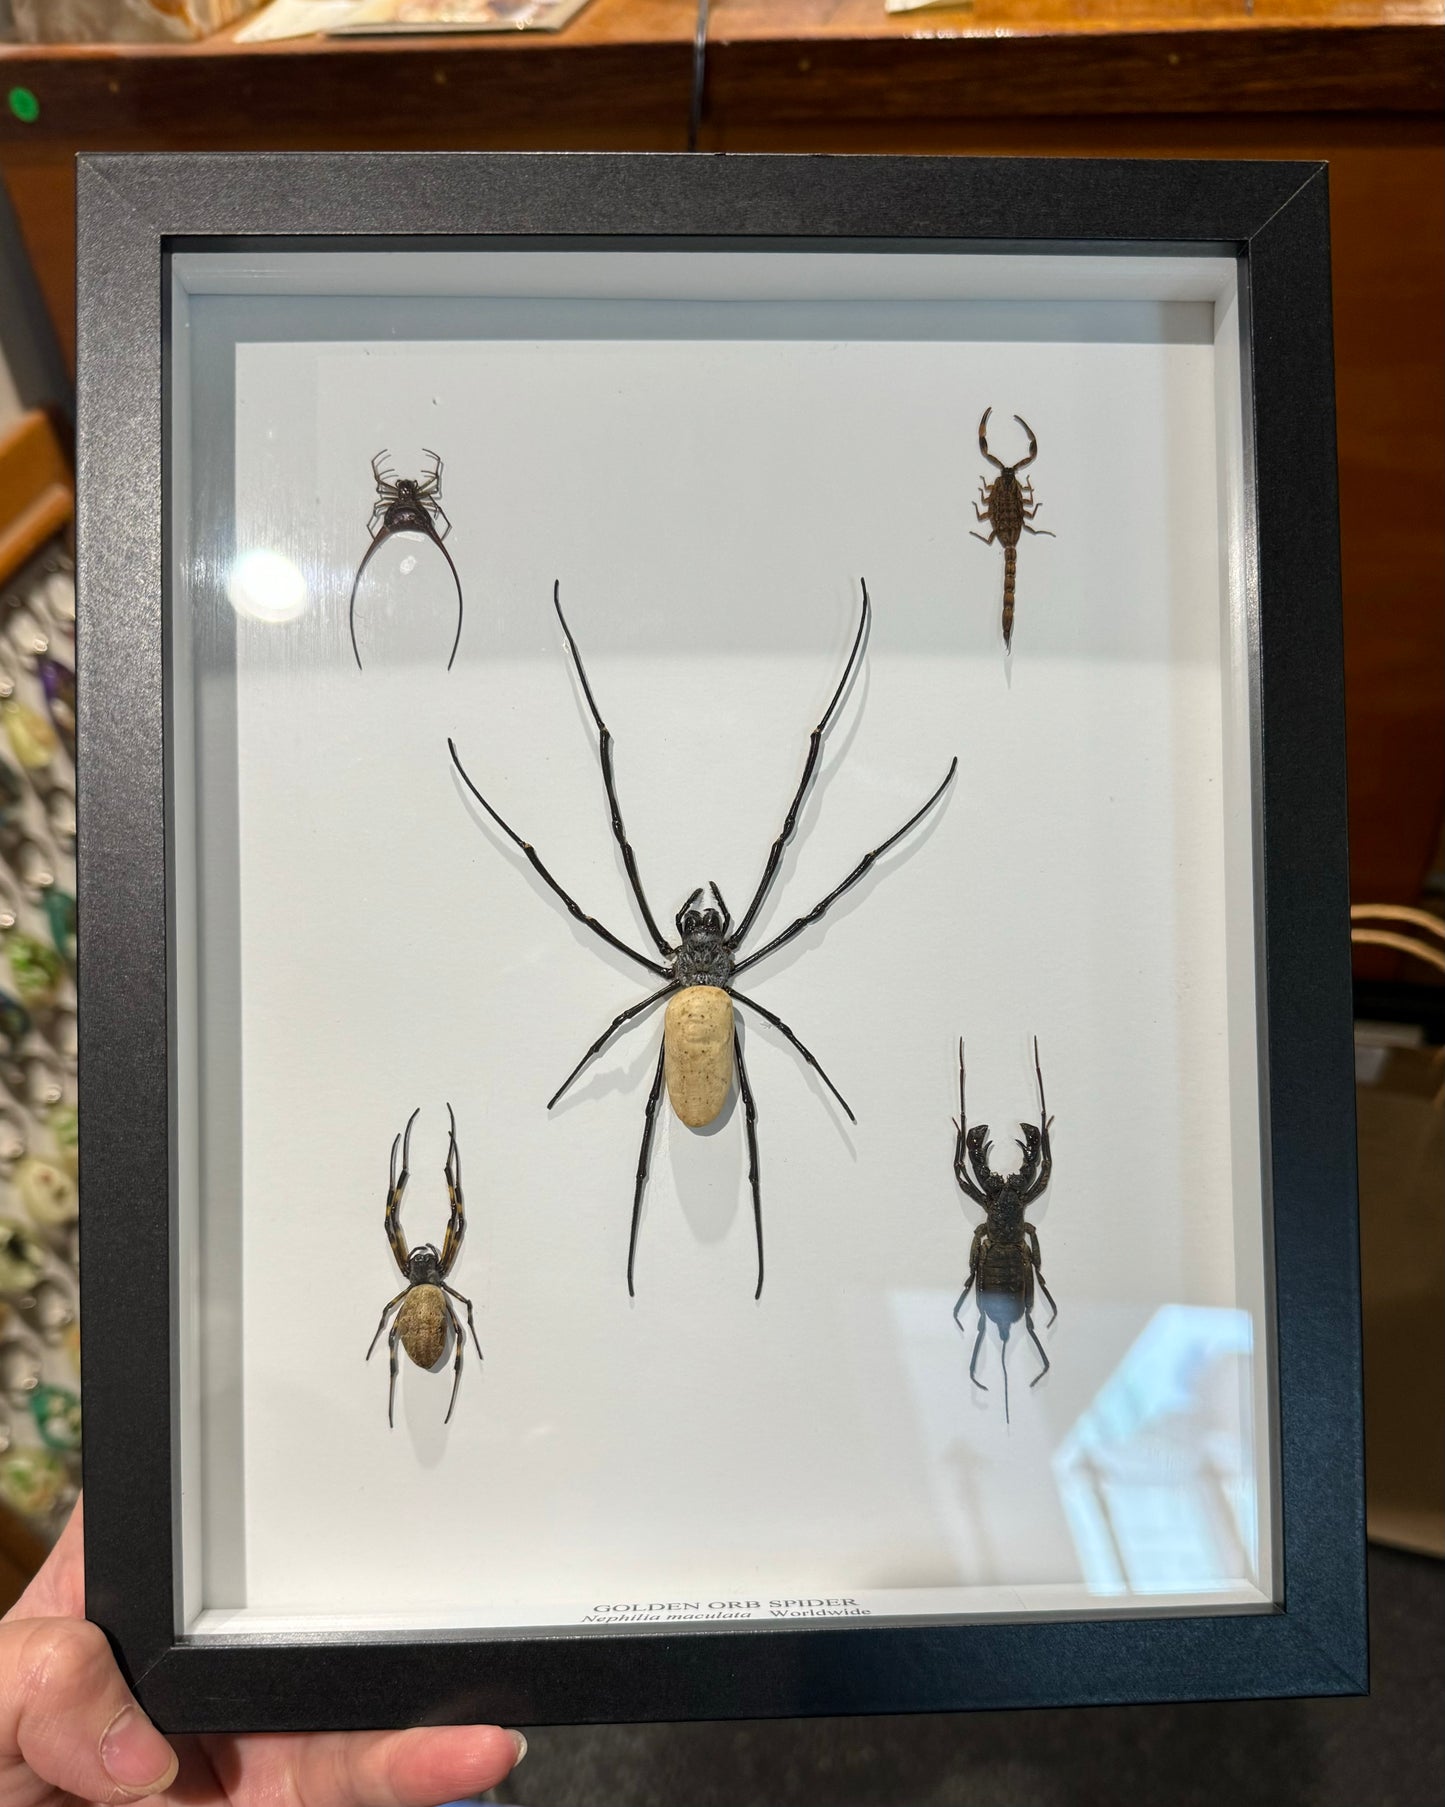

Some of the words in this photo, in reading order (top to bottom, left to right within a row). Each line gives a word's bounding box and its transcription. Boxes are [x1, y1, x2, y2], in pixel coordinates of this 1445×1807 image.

[593, 1602, 700, 1613] GOLDEN
[707, 1600, 761, 1610] ORB
[768, 1598, 860, 1608] SPIDER
[667, 1611, 751, 1620] maculata
[769, 1608, 871, 1617] Worldwide
